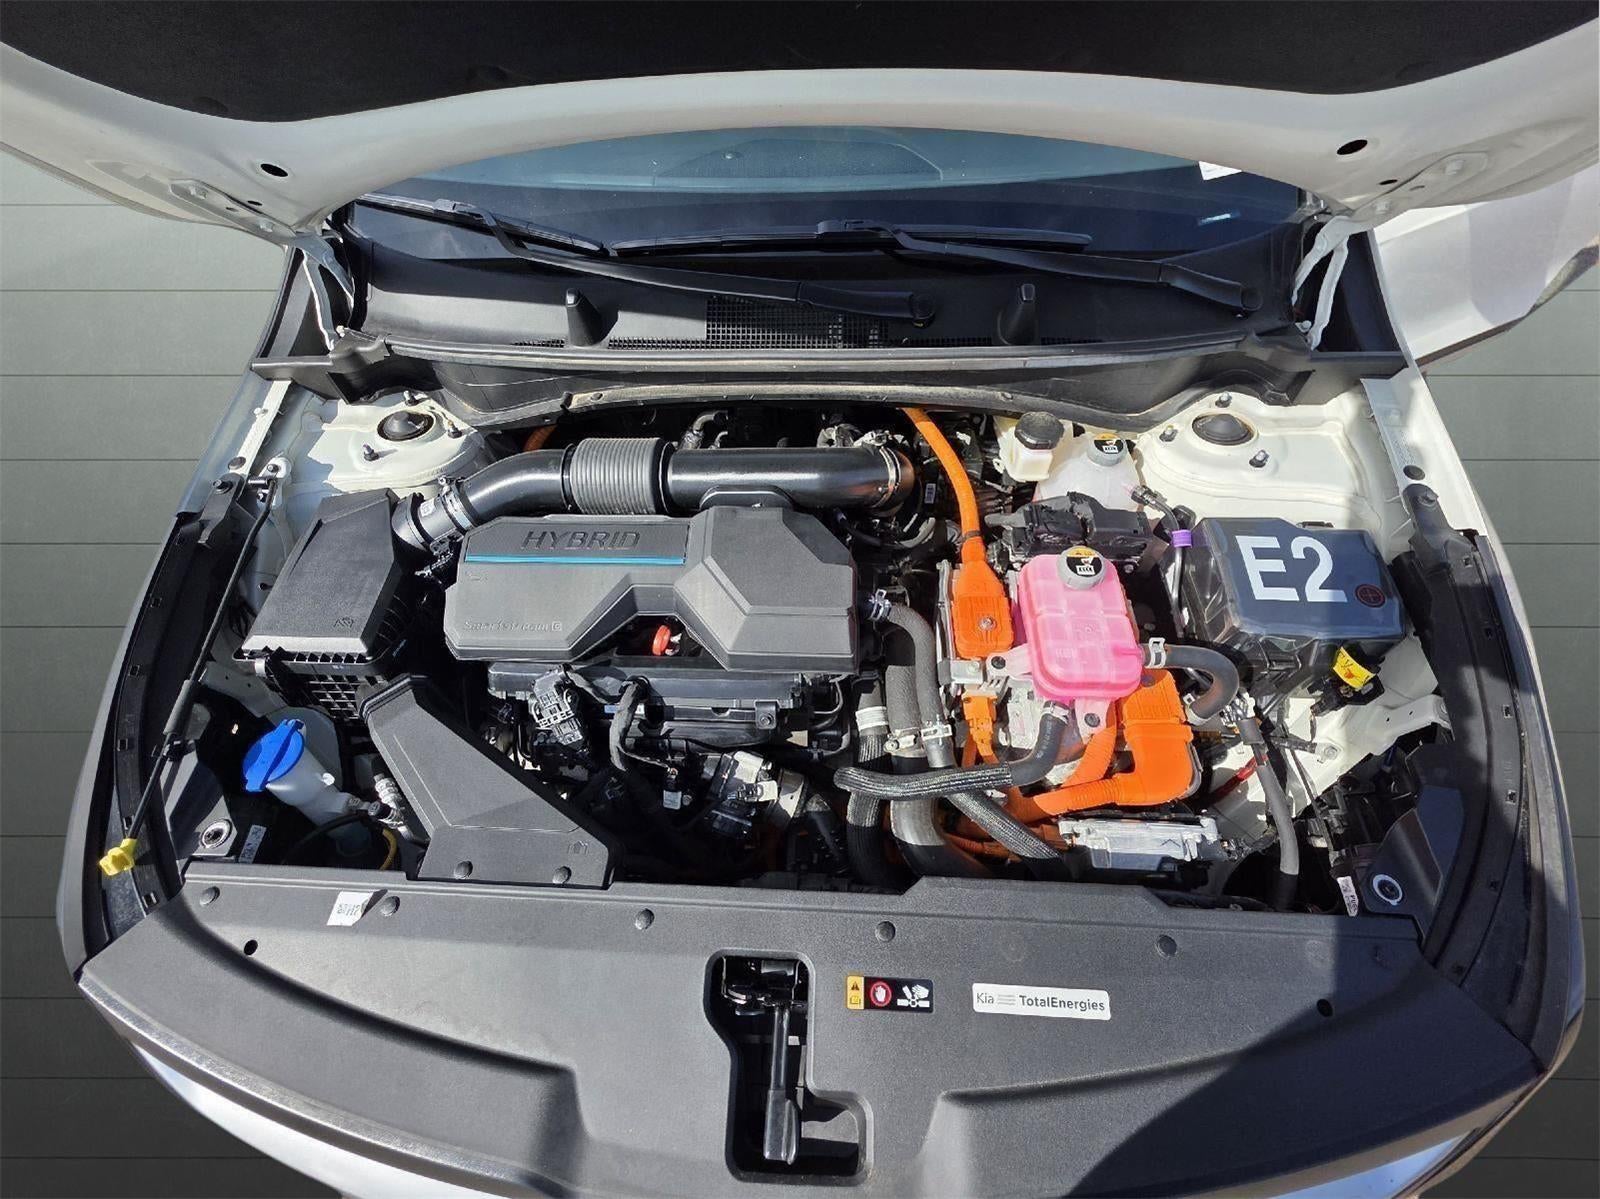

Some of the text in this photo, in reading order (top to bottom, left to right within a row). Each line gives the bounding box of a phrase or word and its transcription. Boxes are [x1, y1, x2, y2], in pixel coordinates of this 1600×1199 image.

[521, 531, 640, 549] HYBRID
[1235, 535, 1348, 602] E2
[976, 993, 1105, 1011] Kia TotalEnergies
